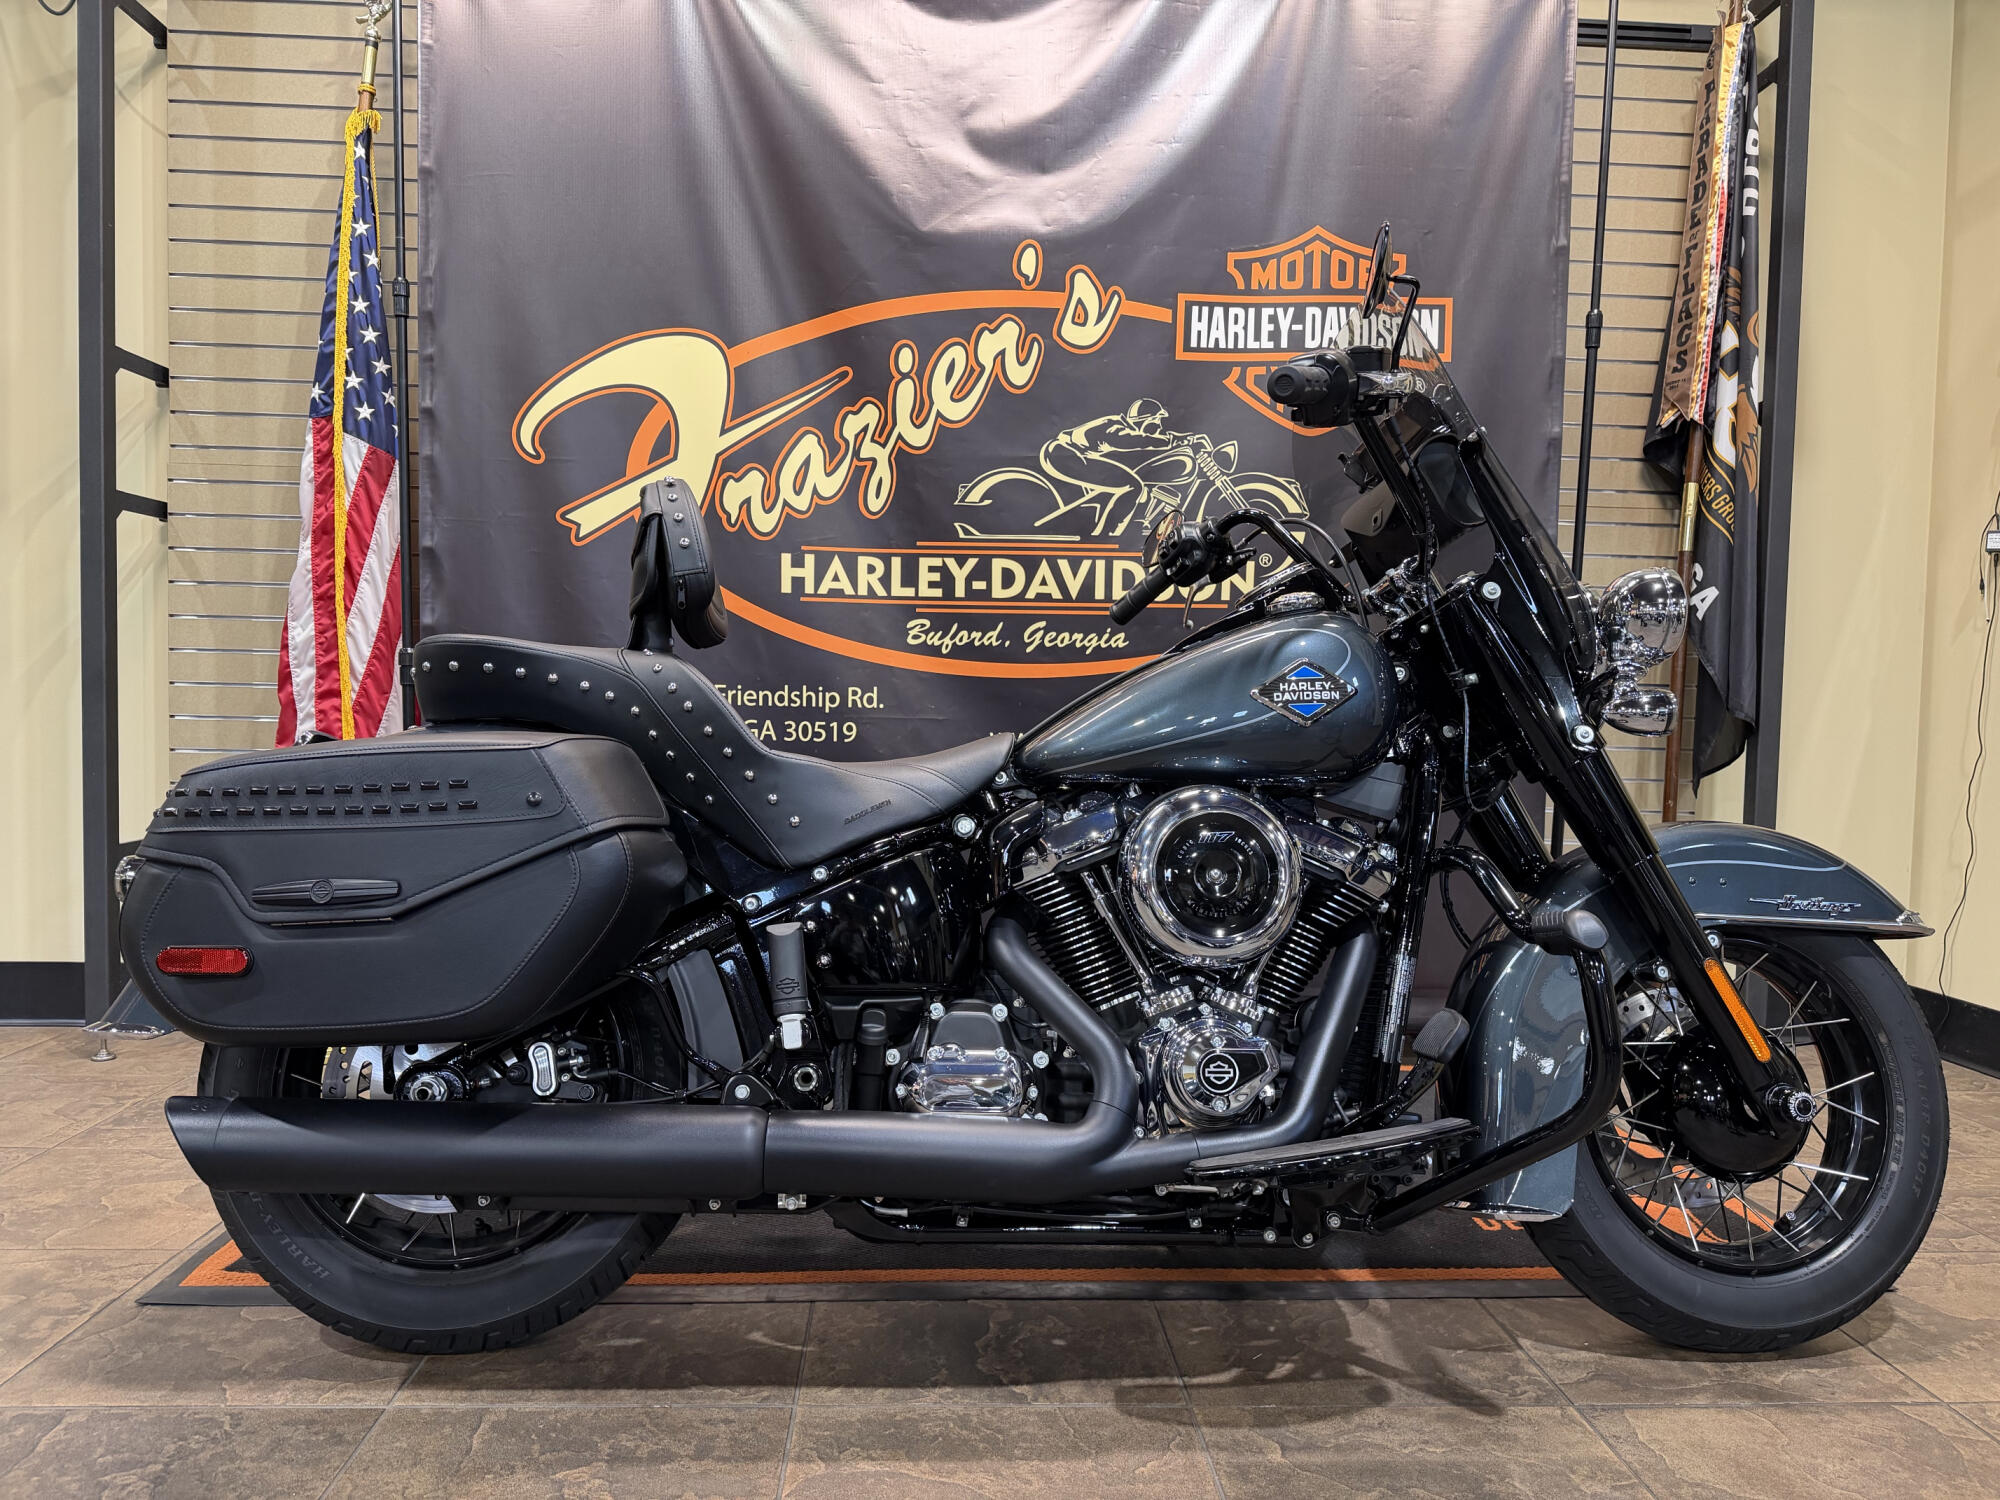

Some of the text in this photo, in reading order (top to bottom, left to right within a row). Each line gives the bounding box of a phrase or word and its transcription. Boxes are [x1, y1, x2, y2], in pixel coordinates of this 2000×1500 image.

[1688, 79, 1716, 231] PARADE
[1671, 243, 1699, 374] FLAGS
[513, 239, 1125, 545] Frazier's
[905, 617, 1130, 654] Buford, Georgia
[847, 686, 885, 709] Rd.
[1273, 690, 1340, 701] DAVIDSON
[783, 720, 858, 743] 30519
